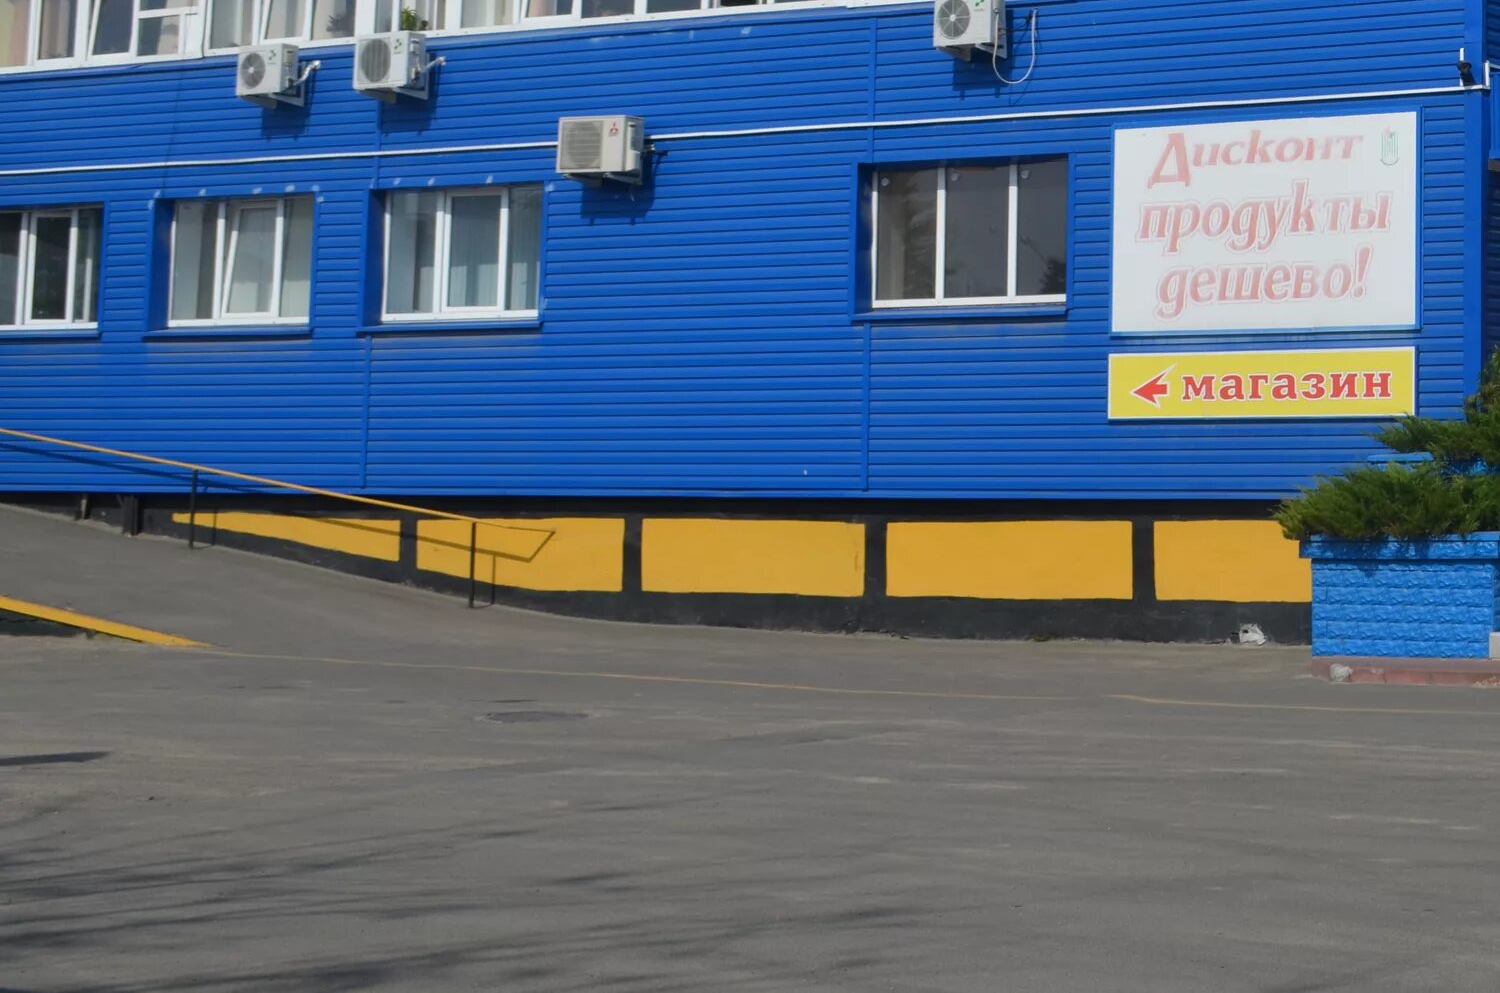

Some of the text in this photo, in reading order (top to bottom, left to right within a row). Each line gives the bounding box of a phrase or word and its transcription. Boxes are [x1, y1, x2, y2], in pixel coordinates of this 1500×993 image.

[1147, 130, 1363, 189] Дисконт
[1136, 179, 1393, 254] продукты
[1153, 246, 1373, 320] дешево!
[1181, 371, 1392, 402] магазин
